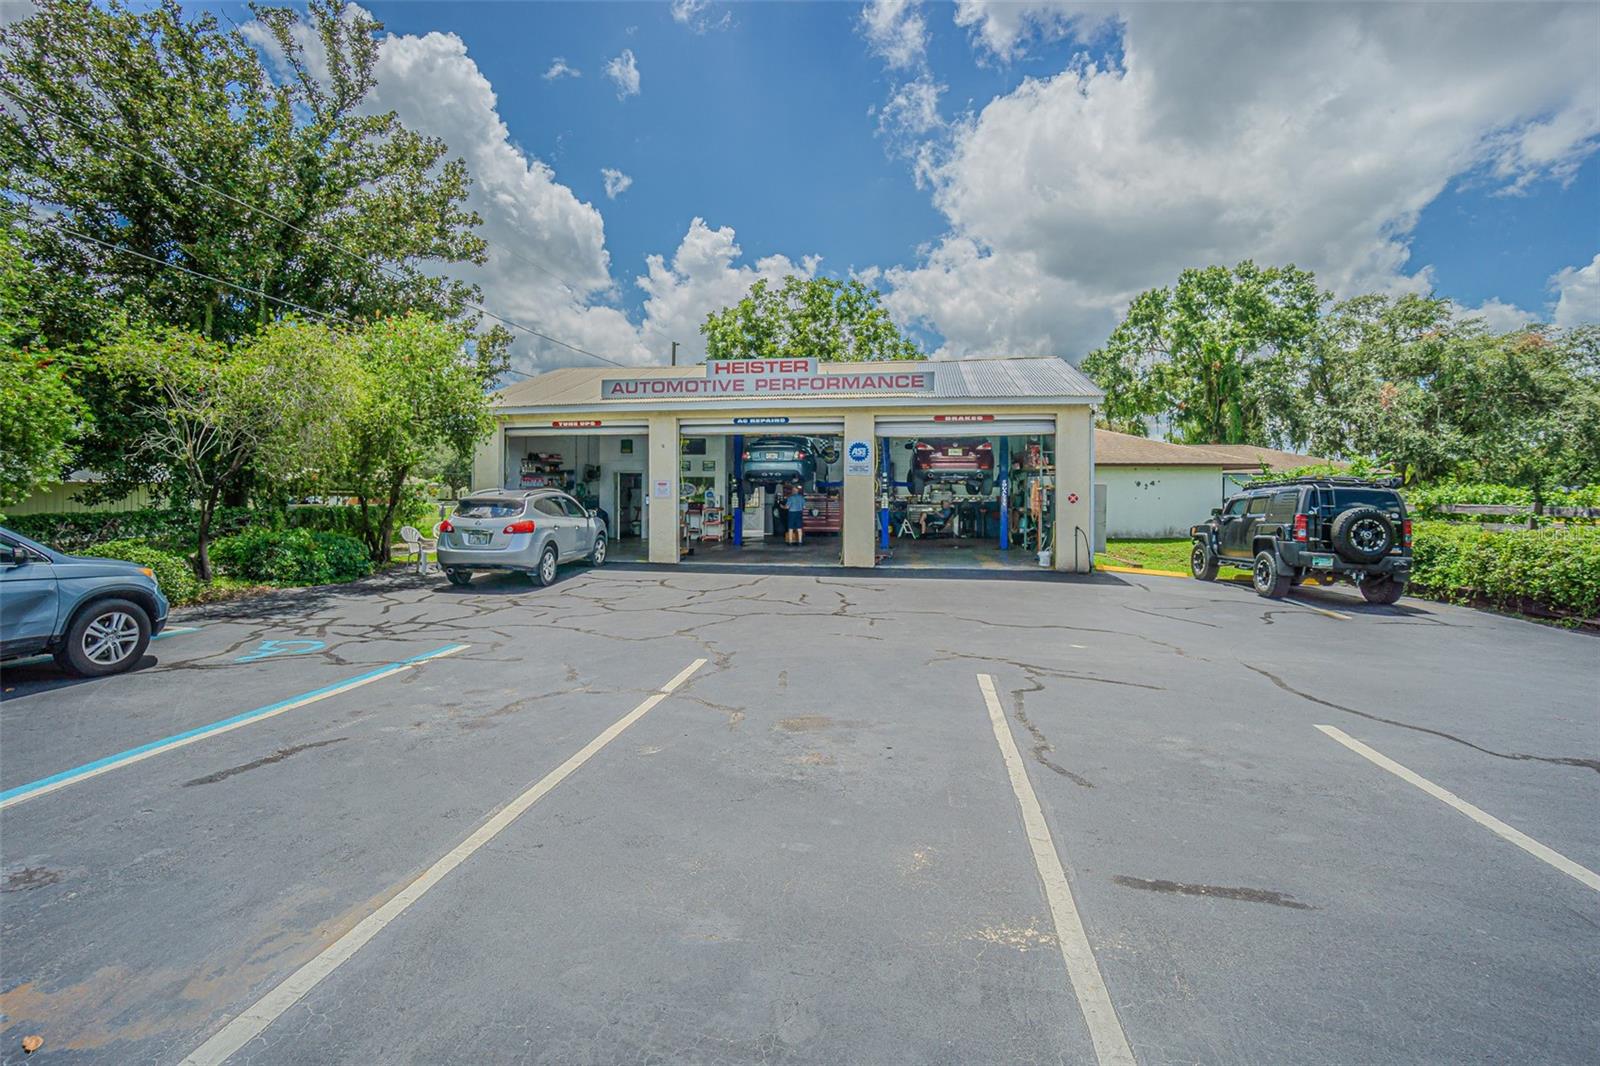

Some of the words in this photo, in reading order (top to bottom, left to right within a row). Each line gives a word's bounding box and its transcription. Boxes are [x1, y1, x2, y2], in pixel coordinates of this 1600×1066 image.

[714, 360, 809, 375] HEISTER
[611, 379, 745, 394] AUTOMOTIVE
[755, 375, 925, 391] PERFORMANCE
